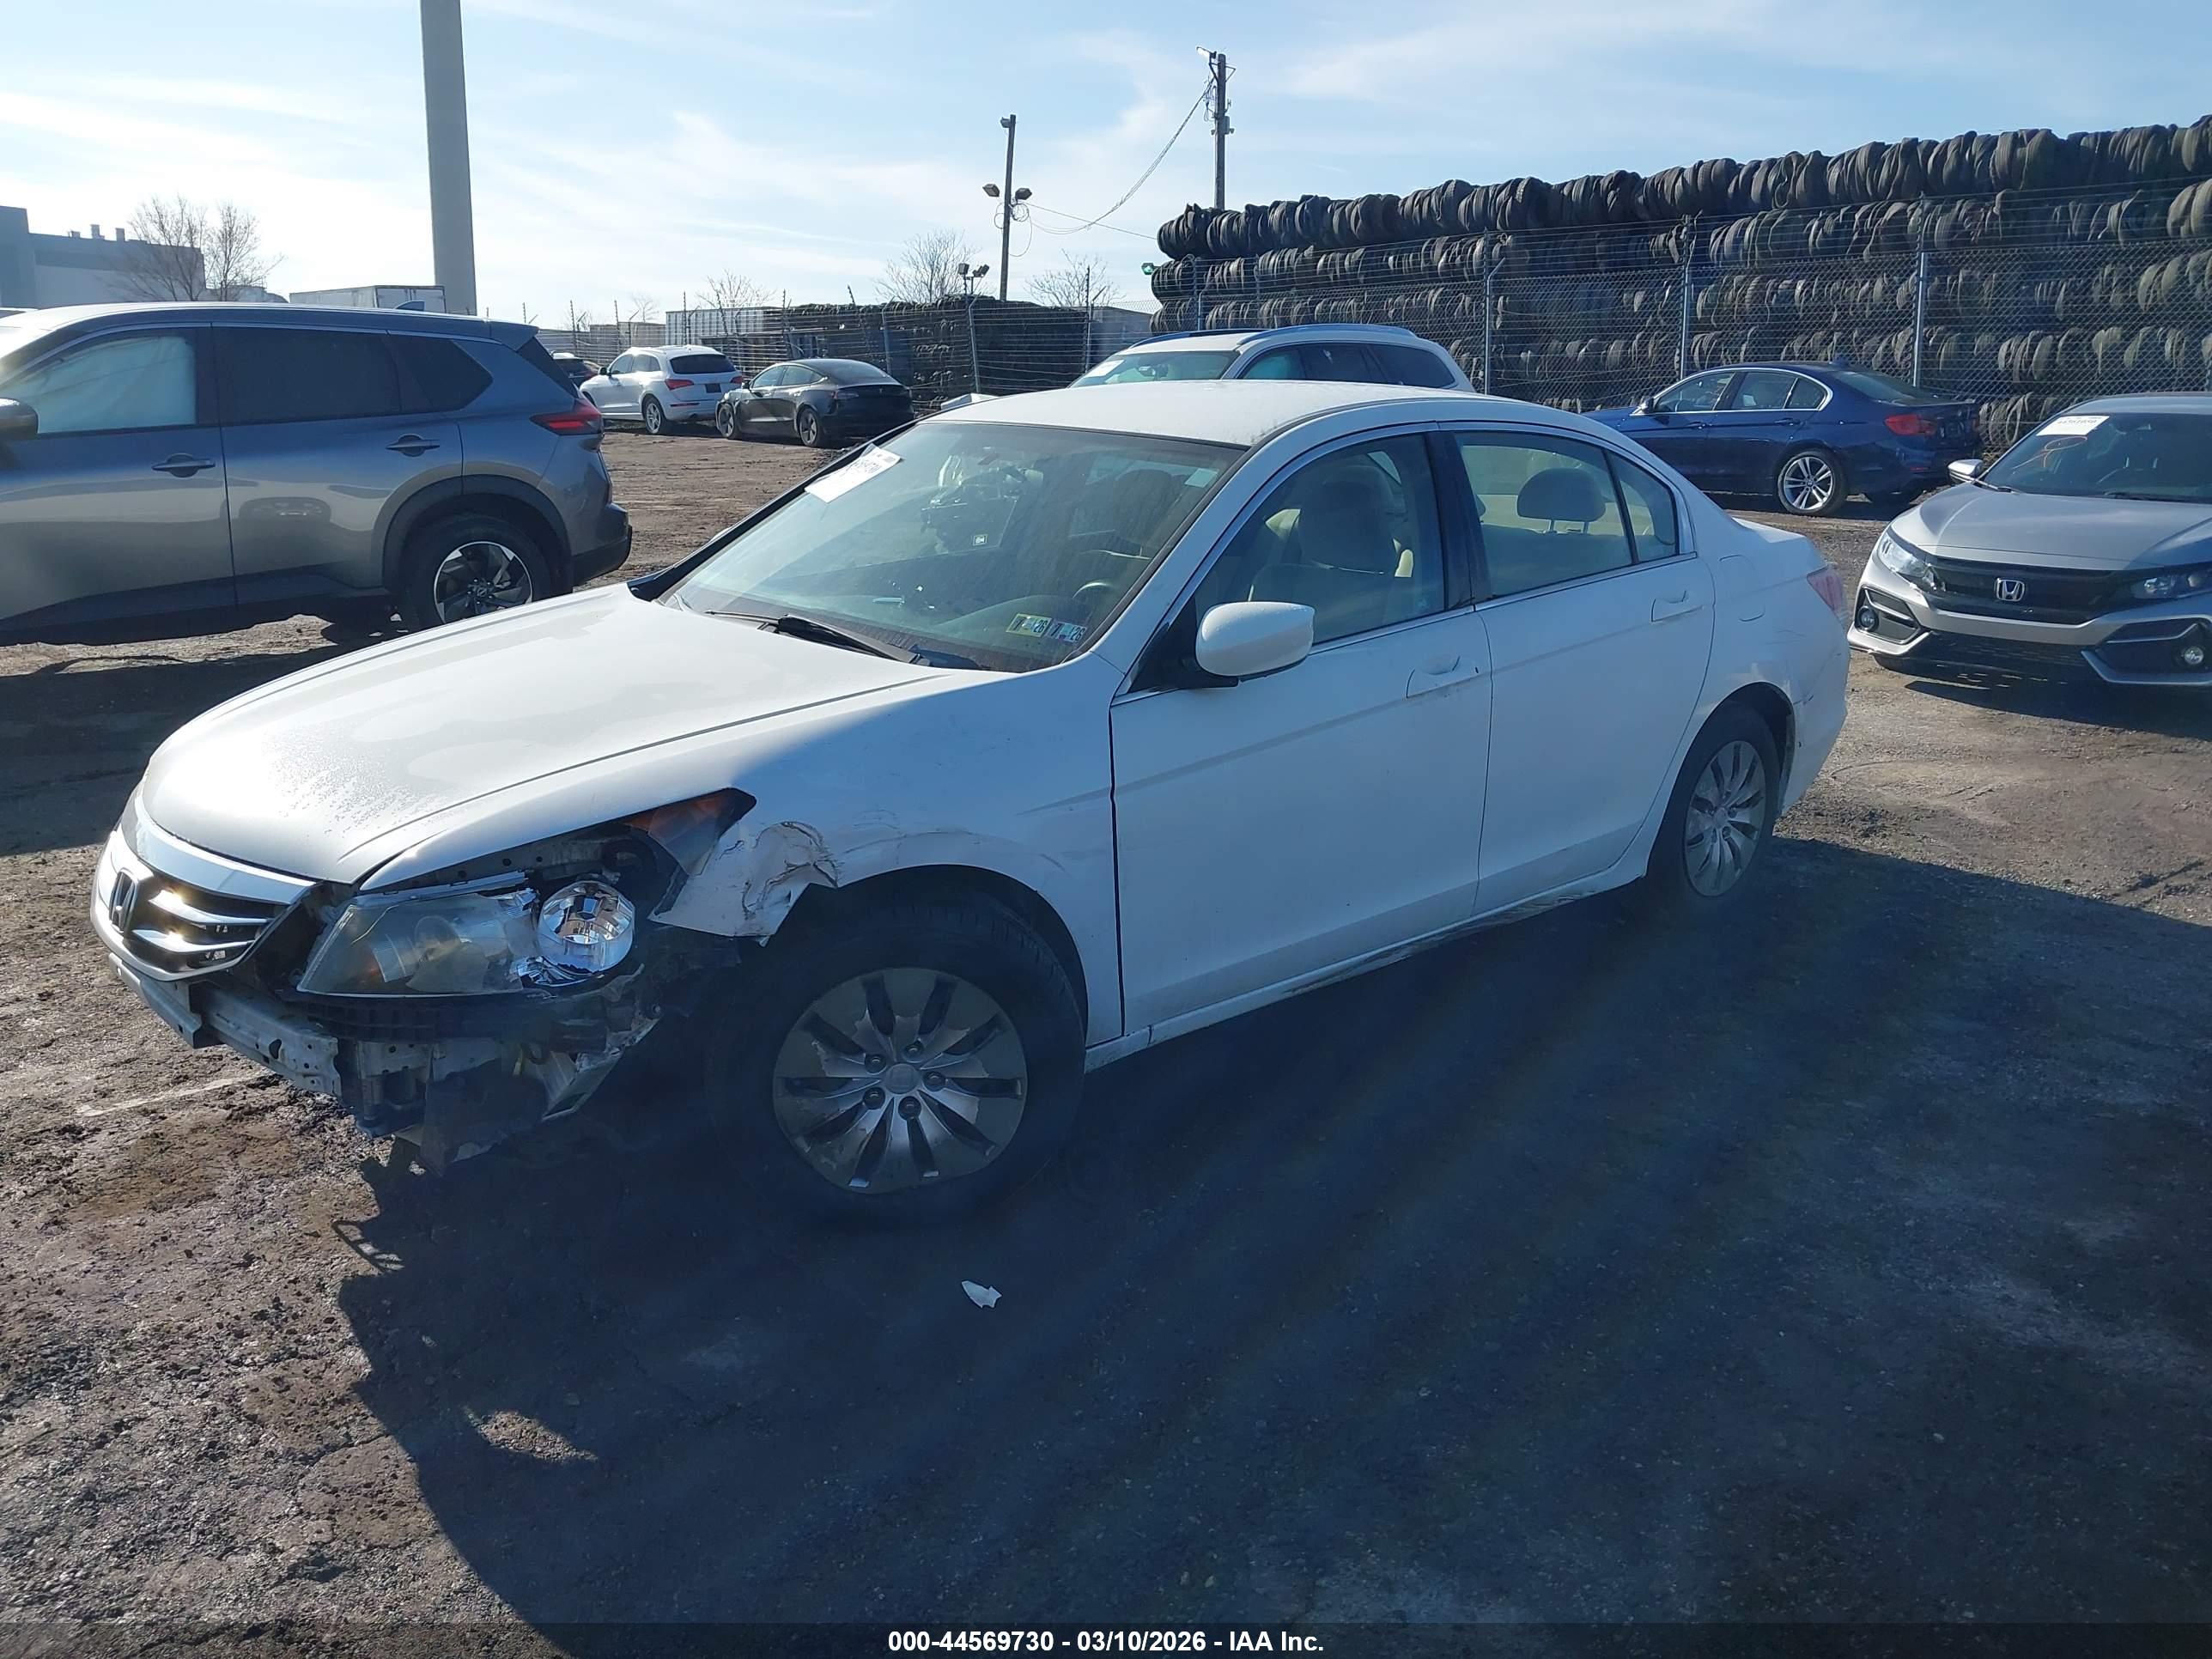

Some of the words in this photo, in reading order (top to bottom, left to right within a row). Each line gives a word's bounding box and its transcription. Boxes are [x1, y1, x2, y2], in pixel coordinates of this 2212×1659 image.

[1033, 619, 1048, 633] 26
[1050, 623, 1063, 636] 7
[1070, 627, 1086, 641] 26
